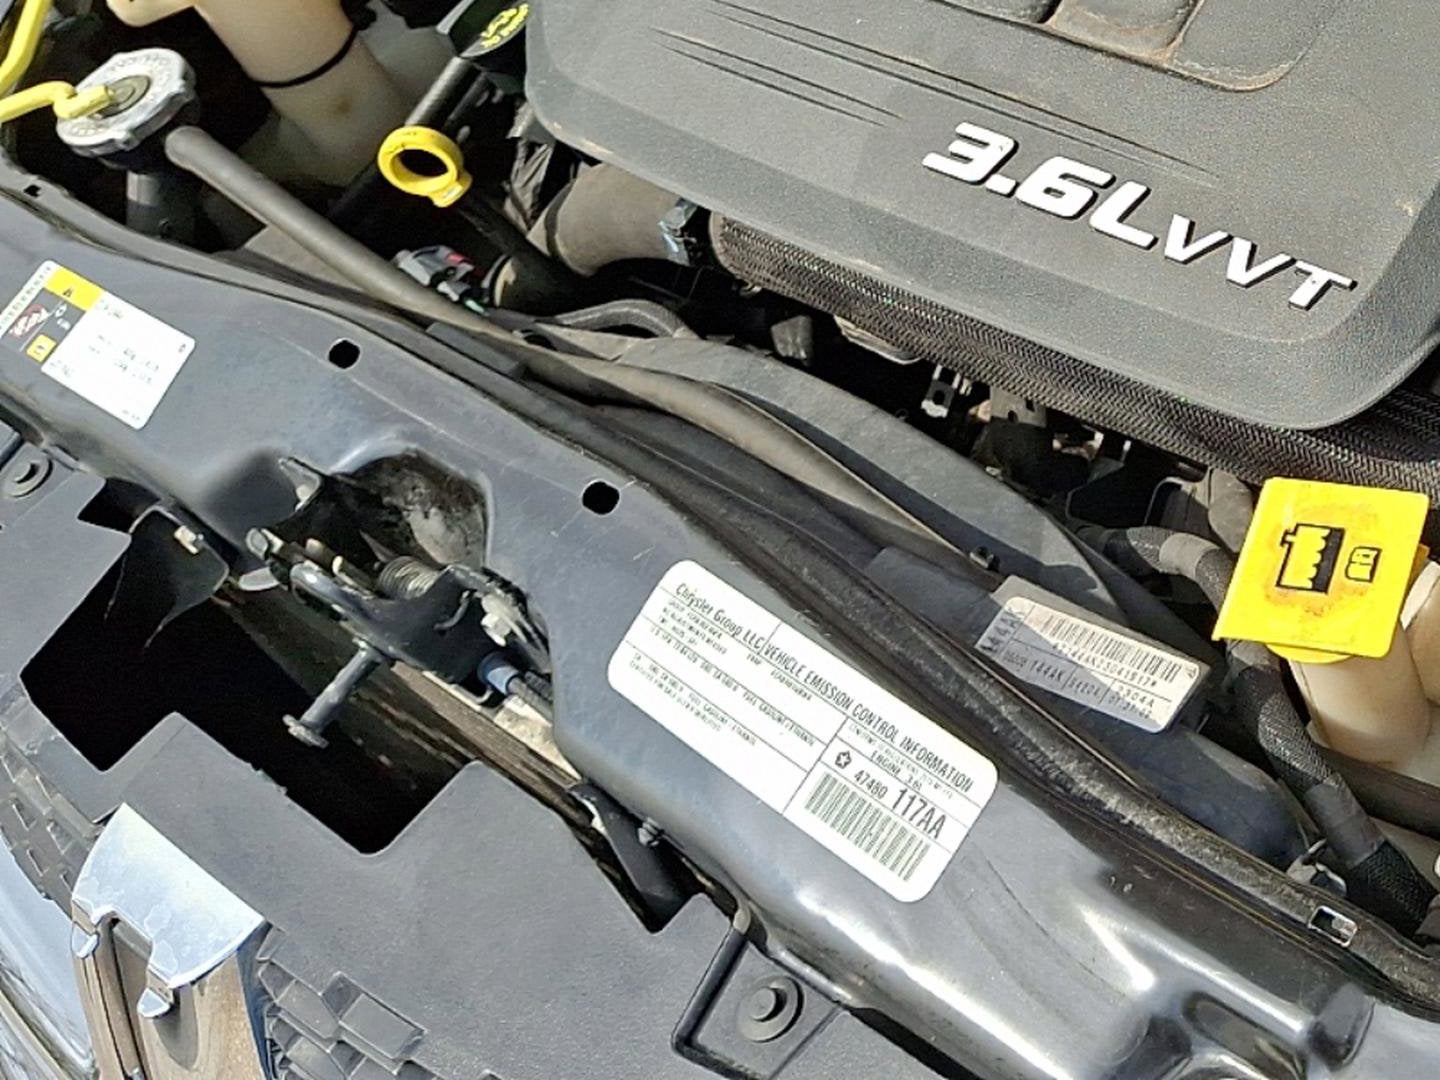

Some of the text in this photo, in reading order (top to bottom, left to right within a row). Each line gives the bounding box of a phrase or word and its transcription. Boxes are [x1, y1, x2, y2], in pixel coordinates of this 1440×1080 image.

[921, 122, 1356, 310] 3.6L VVT
[672, 581, 716, 619] Chrysler
[709, 606, 746, 639] Group
[740, 627, 765, 651] LLC
[762, 642, 807, 679] VEHICLE
[801, 669, 855, 712] EMISSION
[849, 701, 902, 744] CONTROL
[897, 734, 976, 794] INFORMATION
[850, 766, 950, 840] 47480 117AA
